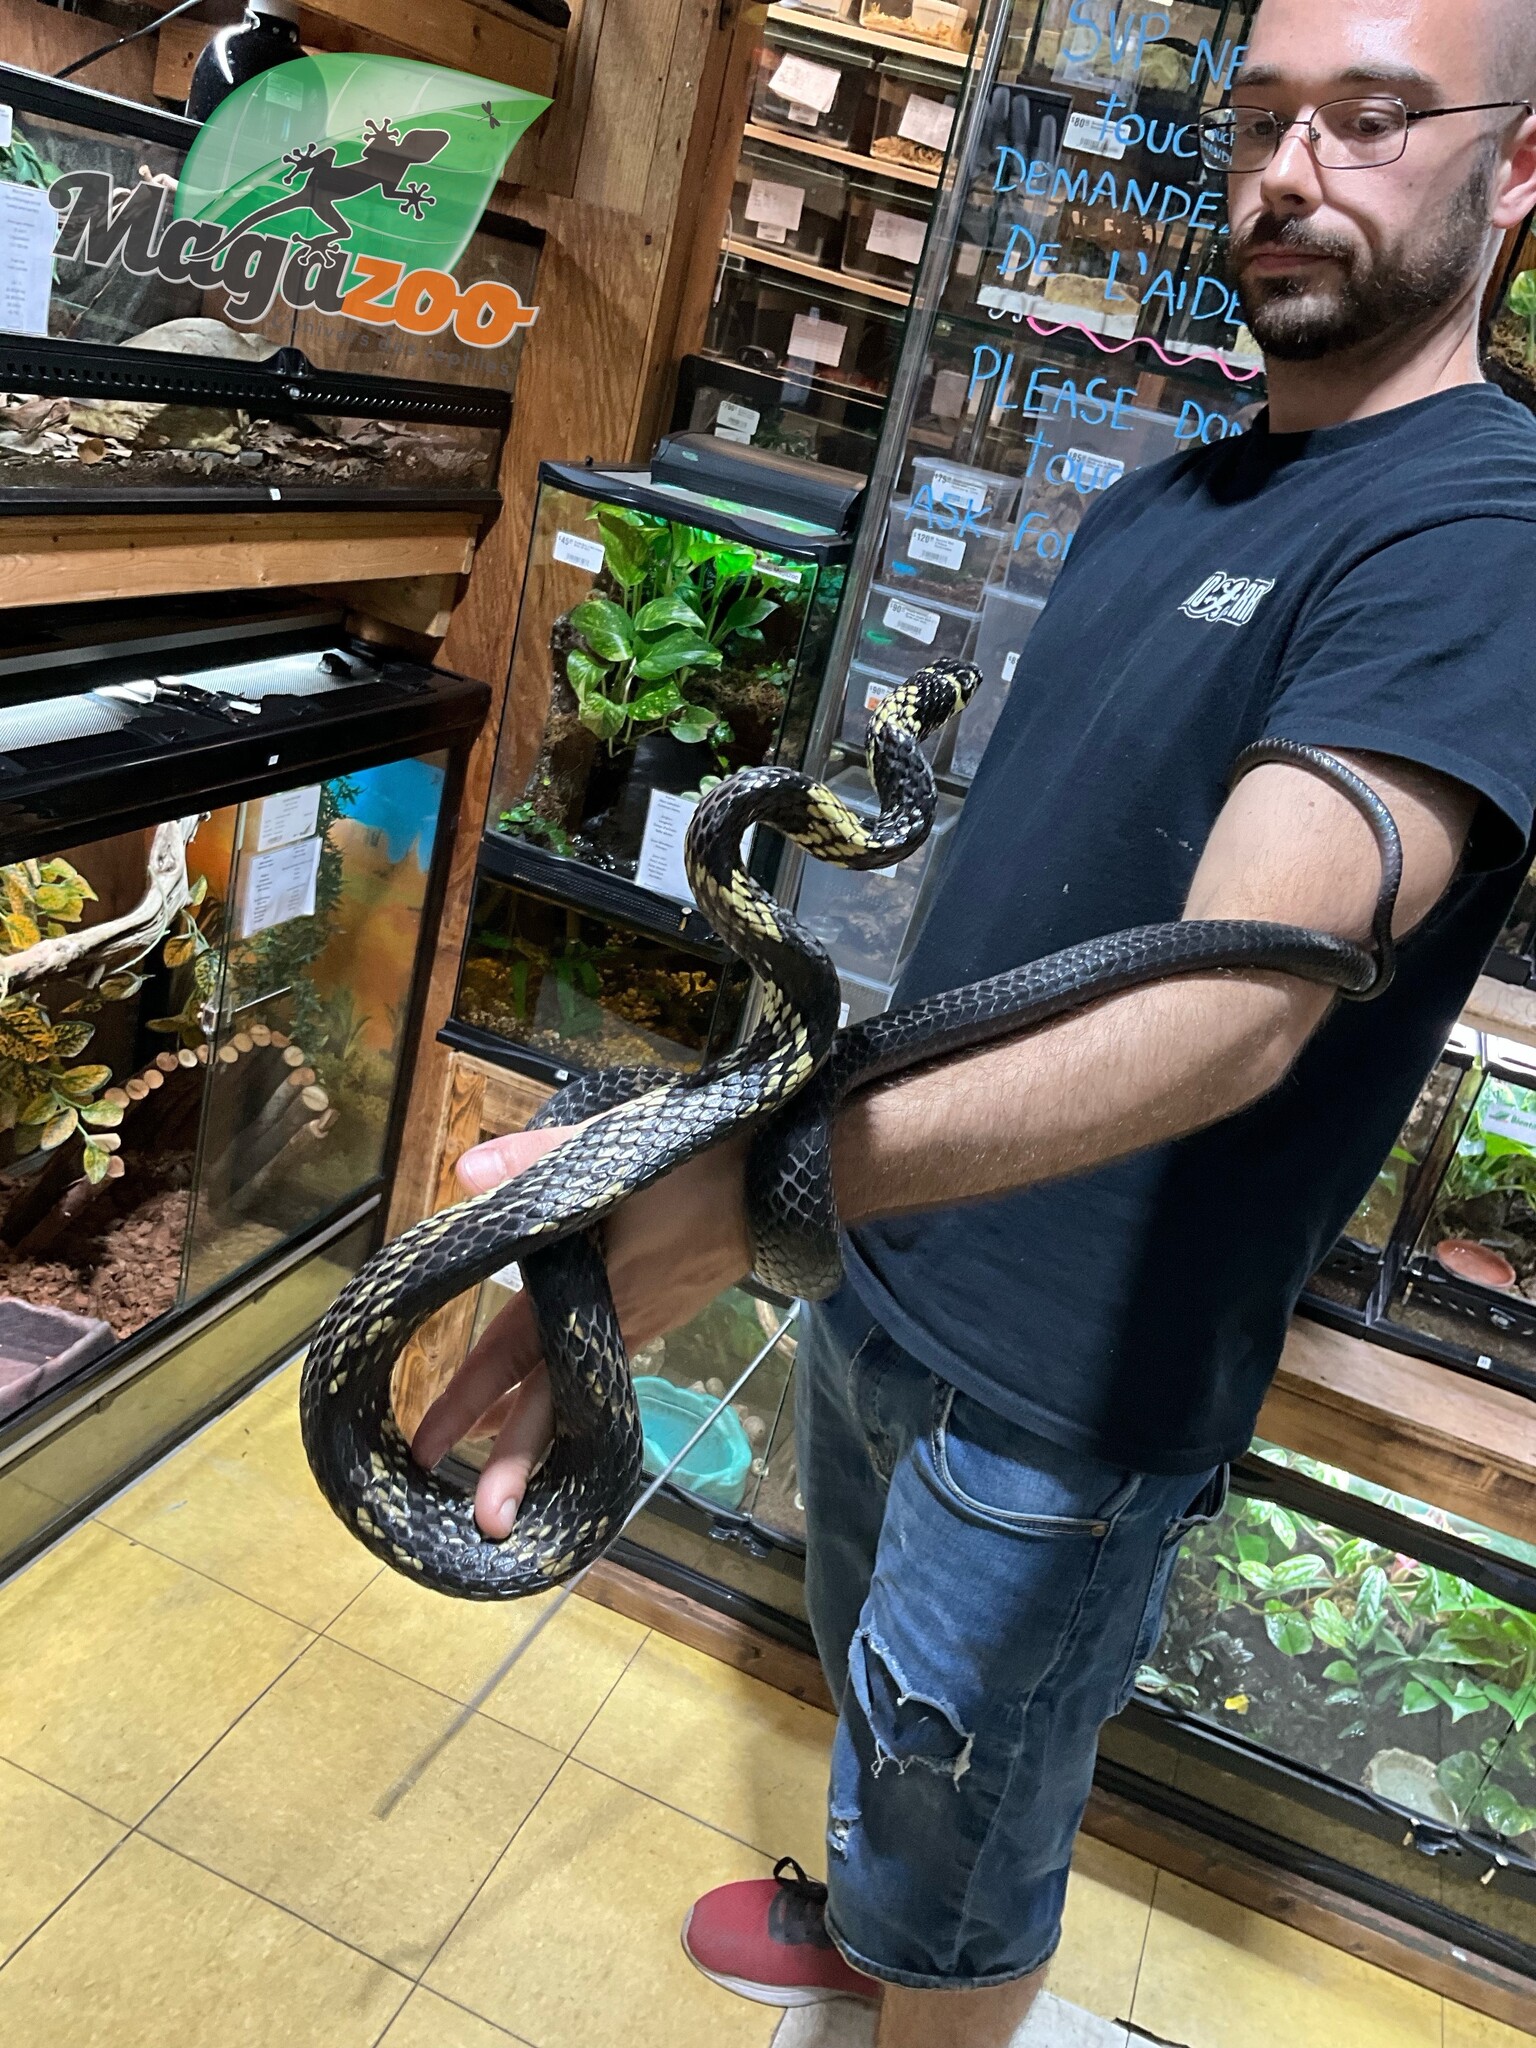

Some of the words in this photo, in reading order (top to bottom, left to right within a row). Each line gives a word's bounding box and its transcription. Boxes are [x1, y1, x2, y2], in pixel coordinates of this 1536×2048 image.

[1062, 0, 1171, 71] SVP
[992, 146, 1229, 234] DEMANDE
[997, 223, 1062, 278] DE
[968, 345, 1138, 431] PLEASE
[904, 484, 993, 538] ASK
